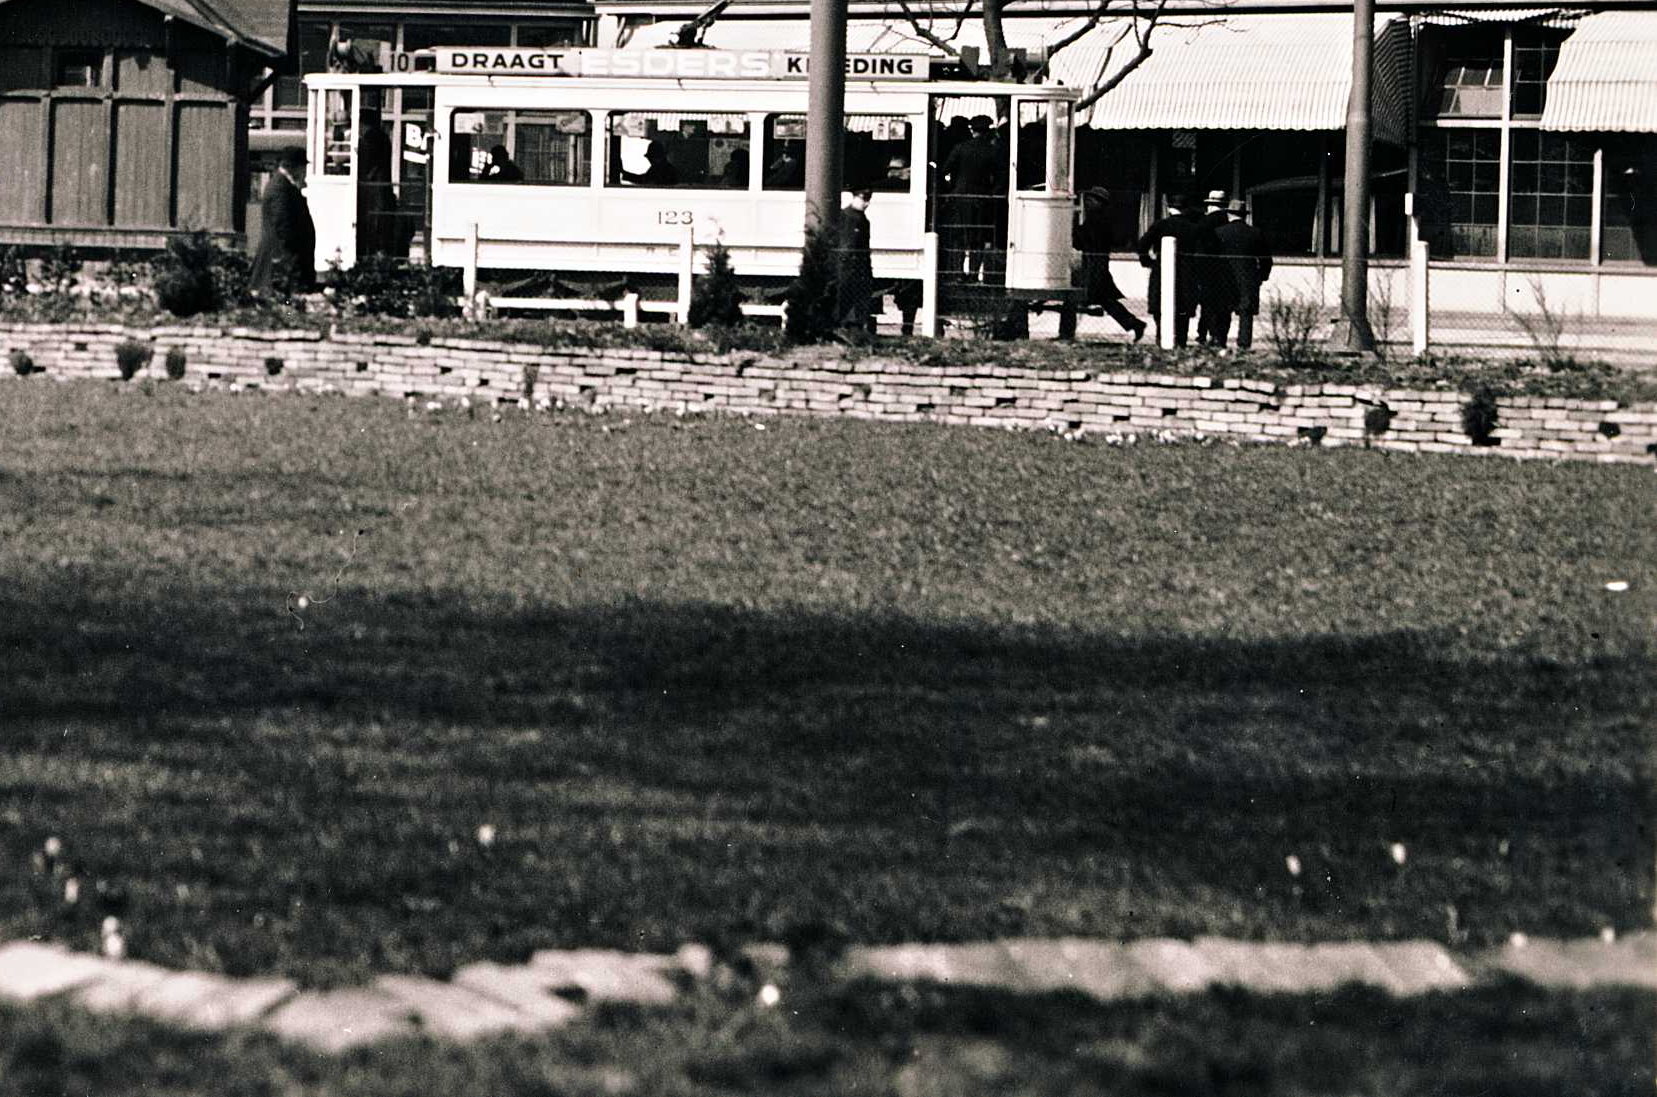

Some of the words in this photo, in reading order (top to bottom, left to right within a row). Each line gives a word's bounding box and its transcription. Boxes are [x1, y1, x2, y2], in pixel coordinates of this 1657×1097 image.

[452, 53, 564, 69] DRAAGT
[787, 57, 913, 74] KDING
[658, 210, 694, 225] 123
